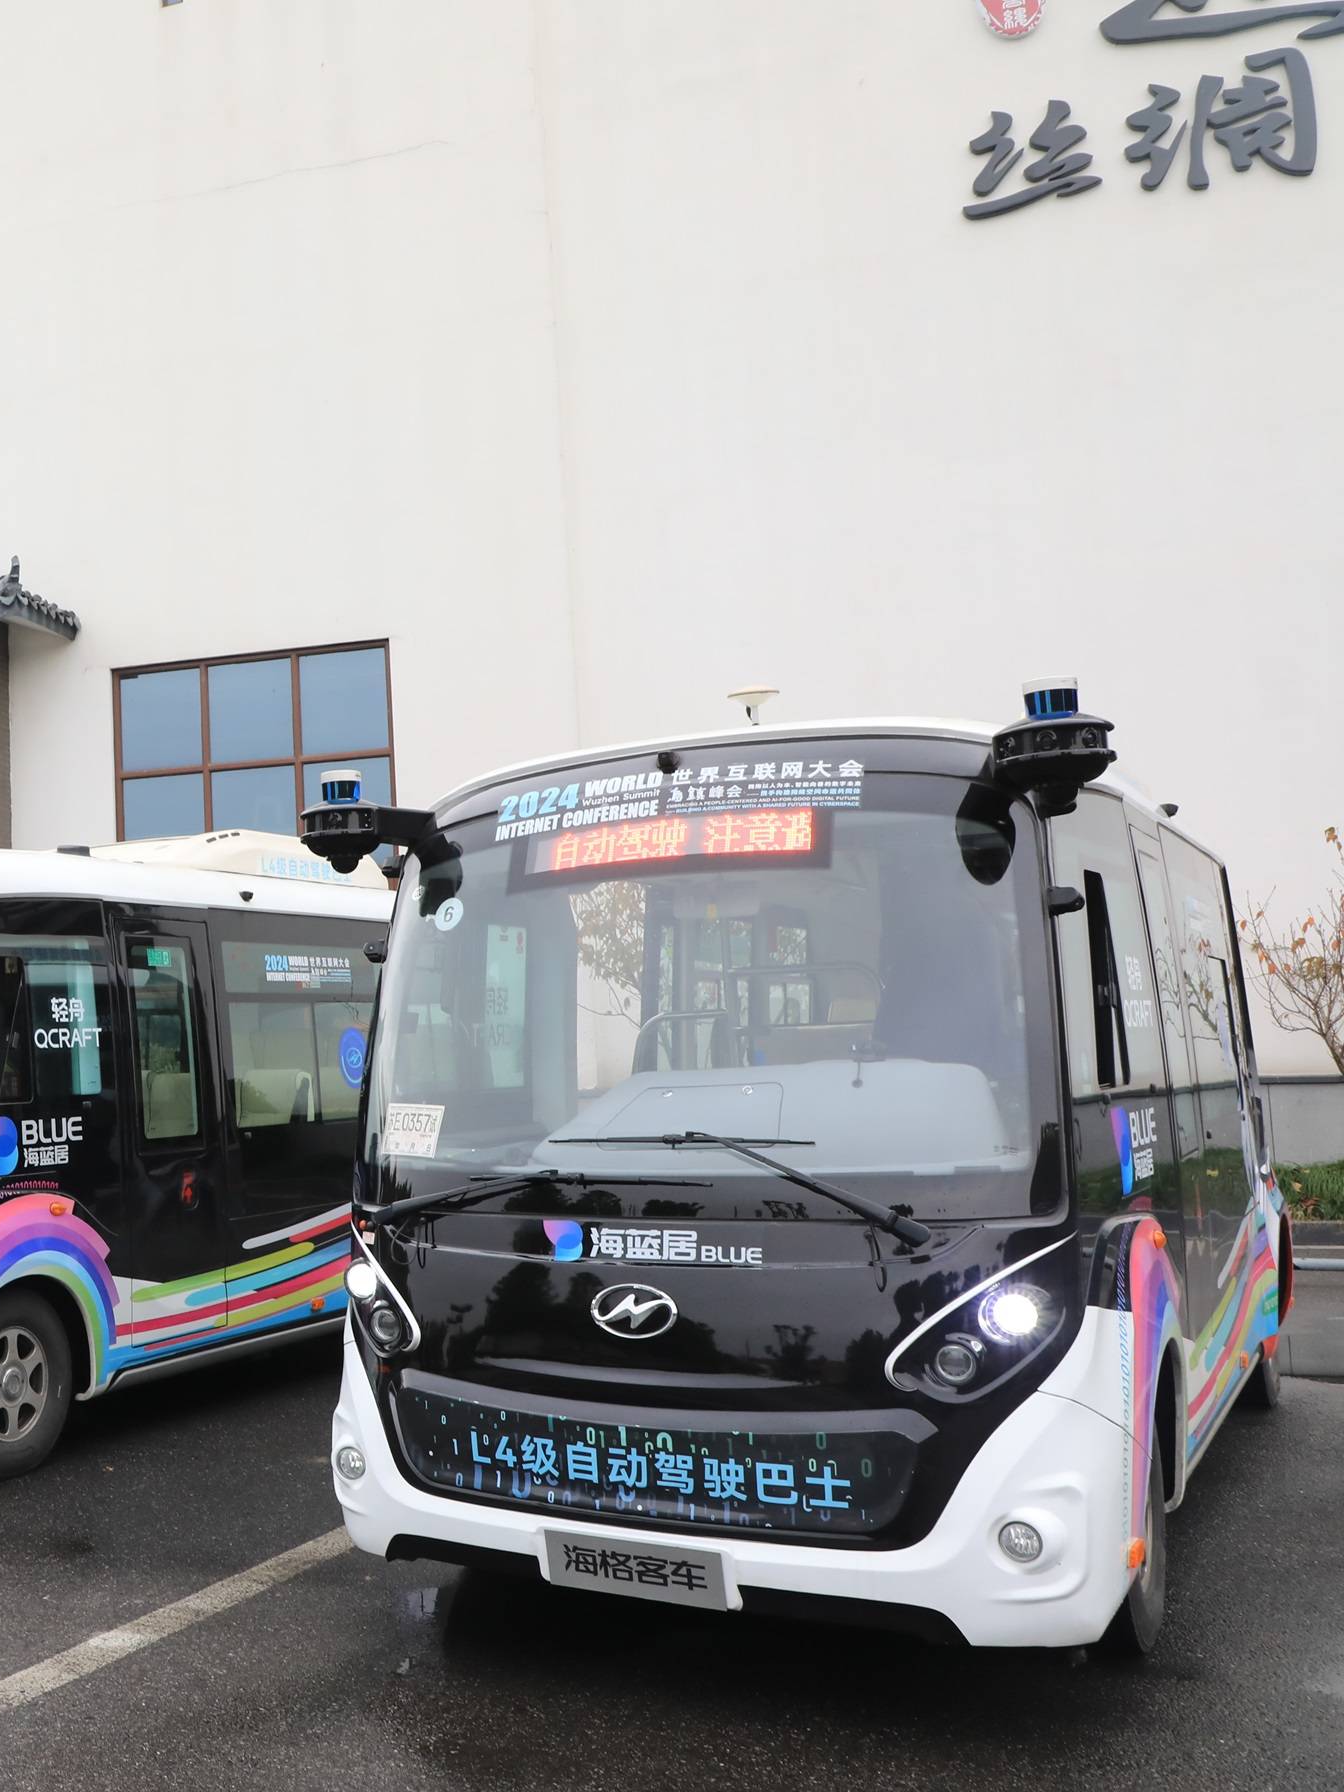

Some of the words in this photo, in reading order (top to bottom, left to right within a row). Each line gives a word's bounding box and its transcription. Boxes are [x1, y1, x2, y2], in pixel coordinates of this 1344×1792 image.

[670, 759, 865, 786] 世界互联网大会
[497, 782, 581, 824] 2024
[584, 771, 664, 798] WORLD
[582, 794, 620, 807] Wuzhen
[623, 788, 661, 801] Summit
[494, 814, 561, 842] INTERNET
[561, 799, 659, 829] CONFERENCE
[553, 816, 689, 871] 自动驾驶
[443, 905, 456, 923] 6
[264, 954, 289, 972] 2024
[288, 955, 309, 967] WORLD
[50, 997, 85, 1023] 轻舟
[1123, 999, 1153, 1028] QCRAFT
[33, 1027, 103, 1049] QCRAFT
[21, 1115, 84, 1146] BLUE
[1128, 1106, 1158, 1149] BLUE
[23, 1144, 70, 1168] 海蓝居
[589, 1226, 698, 1262] 海蓝居
[700, 1245, 763, 1265] BLUE
[469, 1429, 852, 1510] L4级自动驾驶巴士
[562, 1542, 709, 1592] 海格客车
